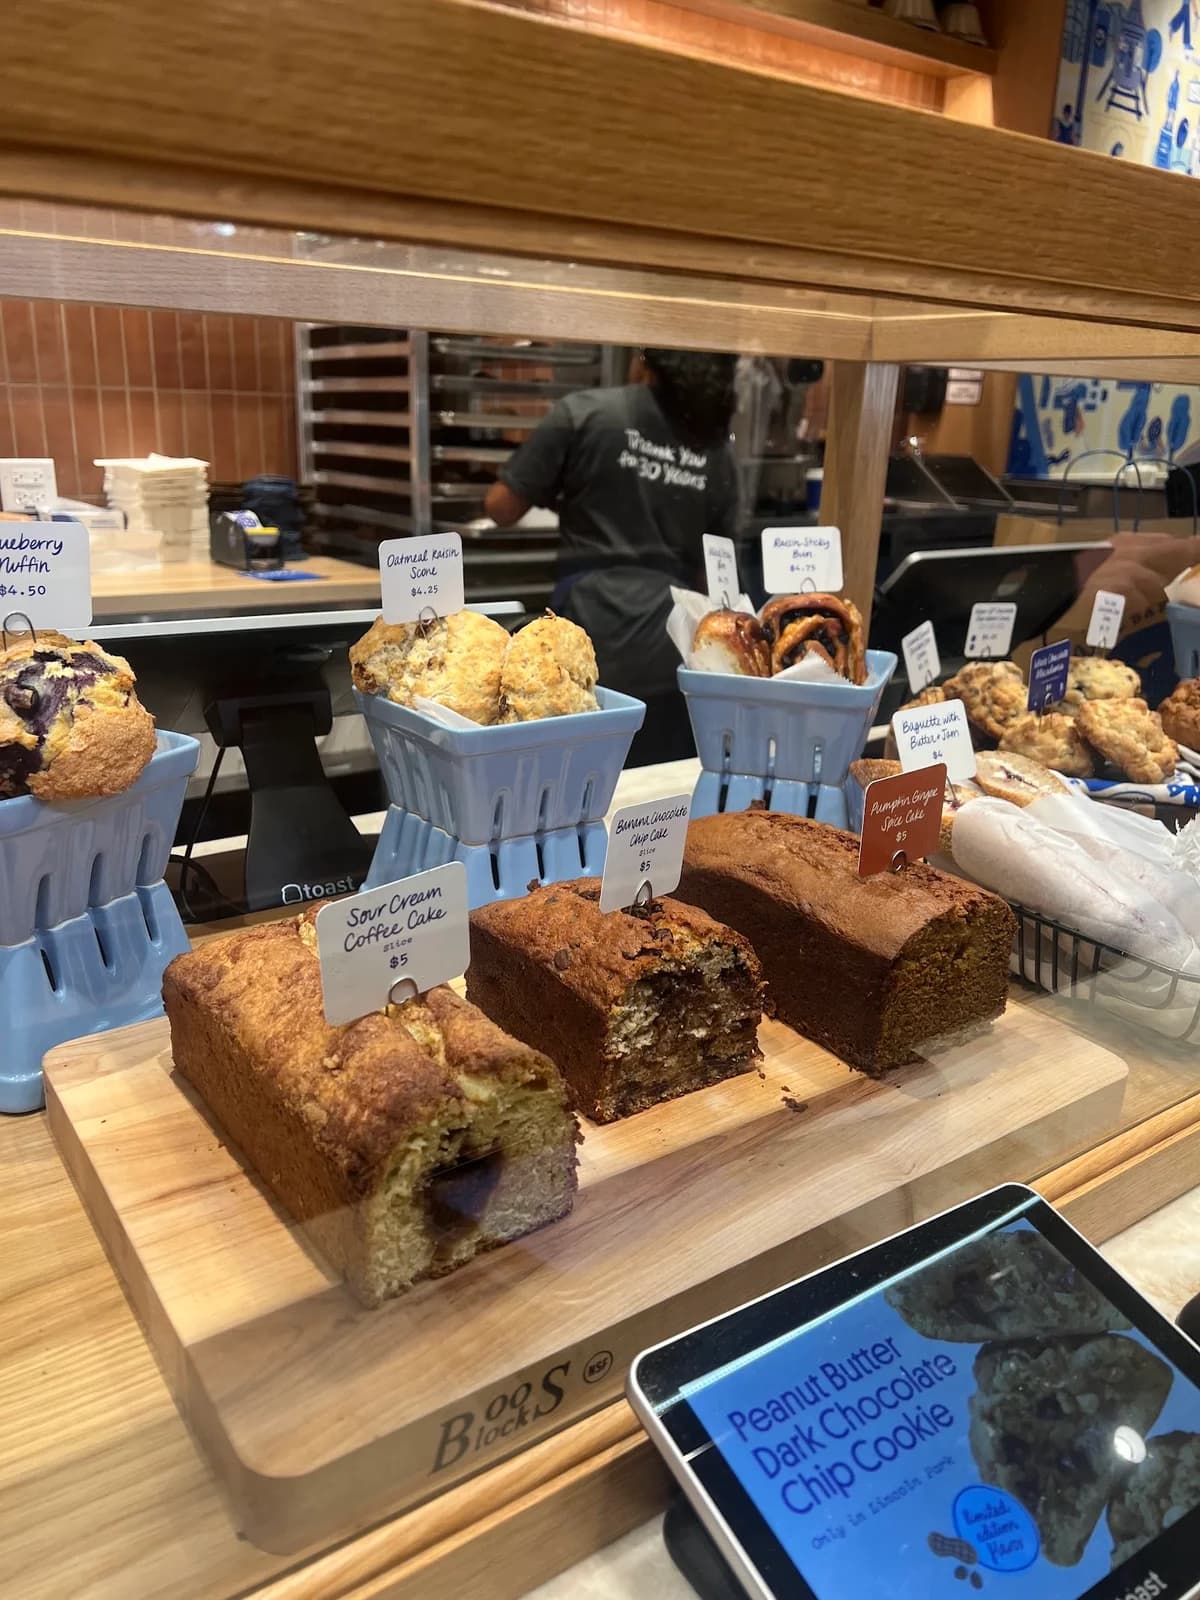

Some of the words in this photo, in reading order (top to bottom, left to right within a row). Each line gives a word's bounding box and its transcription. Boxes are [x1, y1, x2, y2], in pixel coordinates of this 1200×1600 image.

[639, 457, 661, 480] 30
[0, 533, 63, 556] ueberry
[792, 550, 813, 559] Bun
[386, 549, 429, 568] Oatmeal
[432, 547, 460, 560] Raisin
[410, 566, 438, 580] Scone
[0, 584, 47, 597] $4.50
[411, 584, 439, 597] $4.25
[902, 714, 941, 734] Baguette
[943, 711, 961, 725] with
[910, 733, 936, 750] Butter
[941, 727, 960, 741] Jam
[932, 751, 943, 760] $4
[870, 795, 910, 816] Pumpkin
[911, 788, 939, 806] Ginger
[615, 814, 651, 835] Banana
[651, 804, 688, 825] Chocolate
[880, 813, 904, 832] Spice
[905, 809, 926, 824] Cake
[630, 832, 649, 847] Chip
[649, 827, 669, 842] Cake
[895, 830, 908, 842] $5
[640, 860, 652, 872] $5
[303, 875, 357, 898] toast
[346, 902, 387, 928] Sour
[389, 887, 443, 914] Cream
[344, 921, 404, 952] Coffee
[407, 906, 448, 930] Cake
[389, 953, 409, 970] $5
[588, 1357, 609, 1377] NSF
[728, 1374, 831, 1443] Peanut
[819, 1336, 903, 1391] Butter
[751, 1423, 828, 1480] Dark
[818, 1354, 957, 1439] Chocolate
[780, 1461, 856, 1515] Chip
[850, 1403, 955, 1473] Cookie
[848, 1511, 867, 1527] in
[868, 1476, 923, 1514] Lincoln
[924, 1455, 956, 1480] Park
